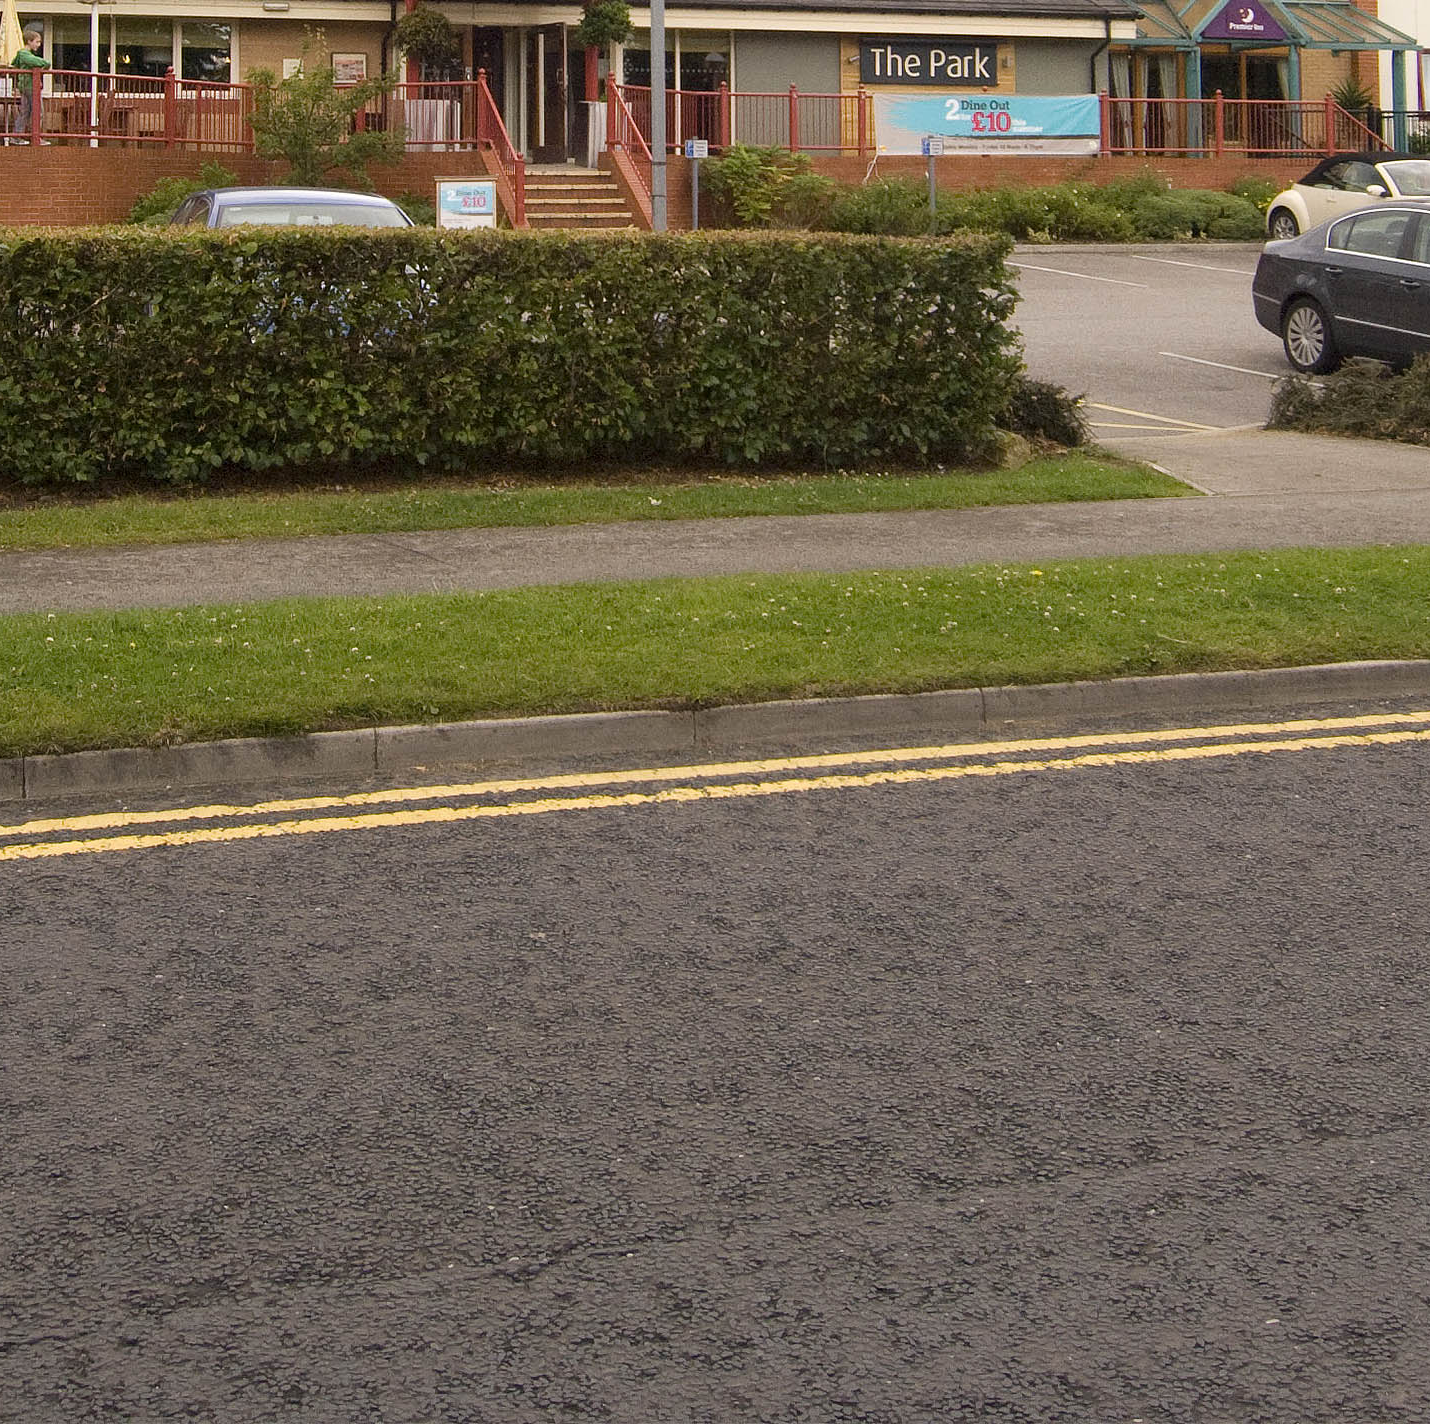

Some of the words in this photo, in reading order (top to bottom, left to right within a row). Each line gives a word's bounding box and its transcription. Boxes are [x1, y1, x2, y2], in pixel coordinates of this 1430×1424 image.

[1229, 22, 1253, 30] Premier
[870, 45, 921, 77] The
[930, 47, 990, 78] Park
[945, 99, 960, 121] 2
[961, 100, 987, 110] Dine
[989, 101, 1010, 110] Out
[972, 112, 1011, 132] £10
[462, 196, 486, 207] £10
